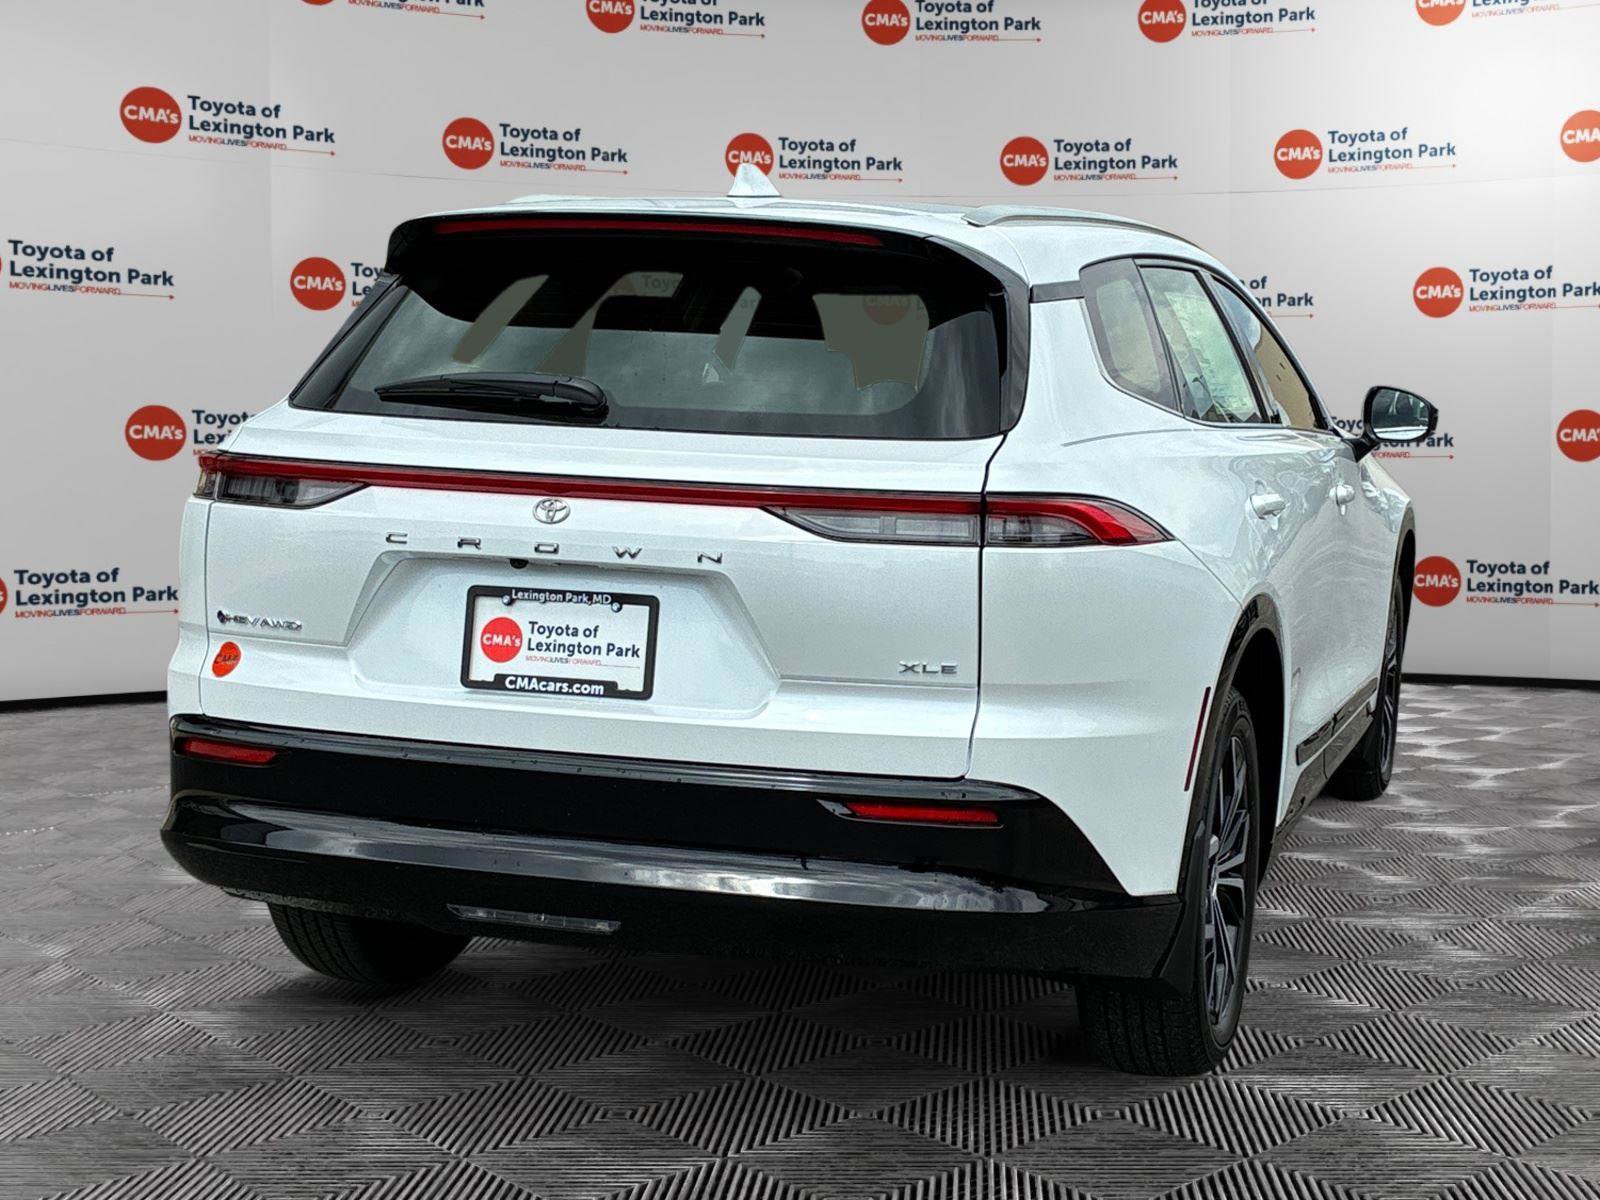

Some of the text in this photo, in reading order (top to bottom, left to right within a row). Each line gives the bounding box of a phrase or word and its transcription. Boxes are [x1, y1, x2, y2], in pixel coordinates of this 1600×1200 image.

[589, 0, 633, 15] CMA's
[640, 6, 765, 26] Lexington Park
[915, 0, 994, 16] Toyota of
[864, 13, 908, 26] CMA's
[916, 17, 1041, 34] Lexington Park
[1140, 10, 1184, 24] CMA's
[1192, 7, 1315, 27] Lexington Park
[124, 105, 179, 124] CMA's
[187, 95, 281, 118] Toyota of
[188, 115, 335, 143] Lexington Park
[499, 123, 581, 142] Toyota of
[1328, 127, 1408, 147] Toyota of
[1562, 128, 1600, 144] CMA
[445, 135, 492, 151] CMA's
[500, 141, 628, 162] Lexington Park
[778, 137, 856, 154] Toyota of
[1053, 138, 1132, 156] Toyota of
[728, 150, 772, 164] CMA's
[1002, 154, 1047, 167] CMA's
[1276, 146, 1321, 161] CMA's
[1328, 143, 1456, 163] Lexington Park
[779, 155, 903, 172] Lexington Park
[1054, 155, 1178, 173] Lexington Park
[8, 239, 114, 262] Toyota of
[9, 260, 174, 286] Lexington Park
[350, 262, 384, 281] Toy
[1469, 265, 1553, 285] Toyota of
[293, 275, 343, 291] CMA's
[1249, 275, 1268, 289] of
[1277, 292, 1314, 307] Park
[1416, 284, 1461, 299] CMA's
[1469, 281, 1600, 303] Lexington Park
[192, 409, 256, 428] Toyot
[129, 425, 183, 440] CMA's
[1416, 433, 1454, 447] ark
[1560, 428, 1600, 442] CMA'
[385, 532, 723, 565] CROWN
[1466, 559, 1550, 577] Toyota of
[14, 567, 120, 588] Toyota of
[1414, 574, 1459, 587] CMA's
[1467, 578, 1599, 596] Lexington Park
[15, 589, 126, 608] Lexington
[132, 586, 179, 602] Park
[511, 589, 562, 604] Lexington
[529, 621, 600, 638] Toyota of
[482, 633, 521, 646] CMA's
[527, 638, 640, 658] Lexington Park
[899, 660, 958, 674] XLE
[504, 676, 605, 695] CMAcars.com
